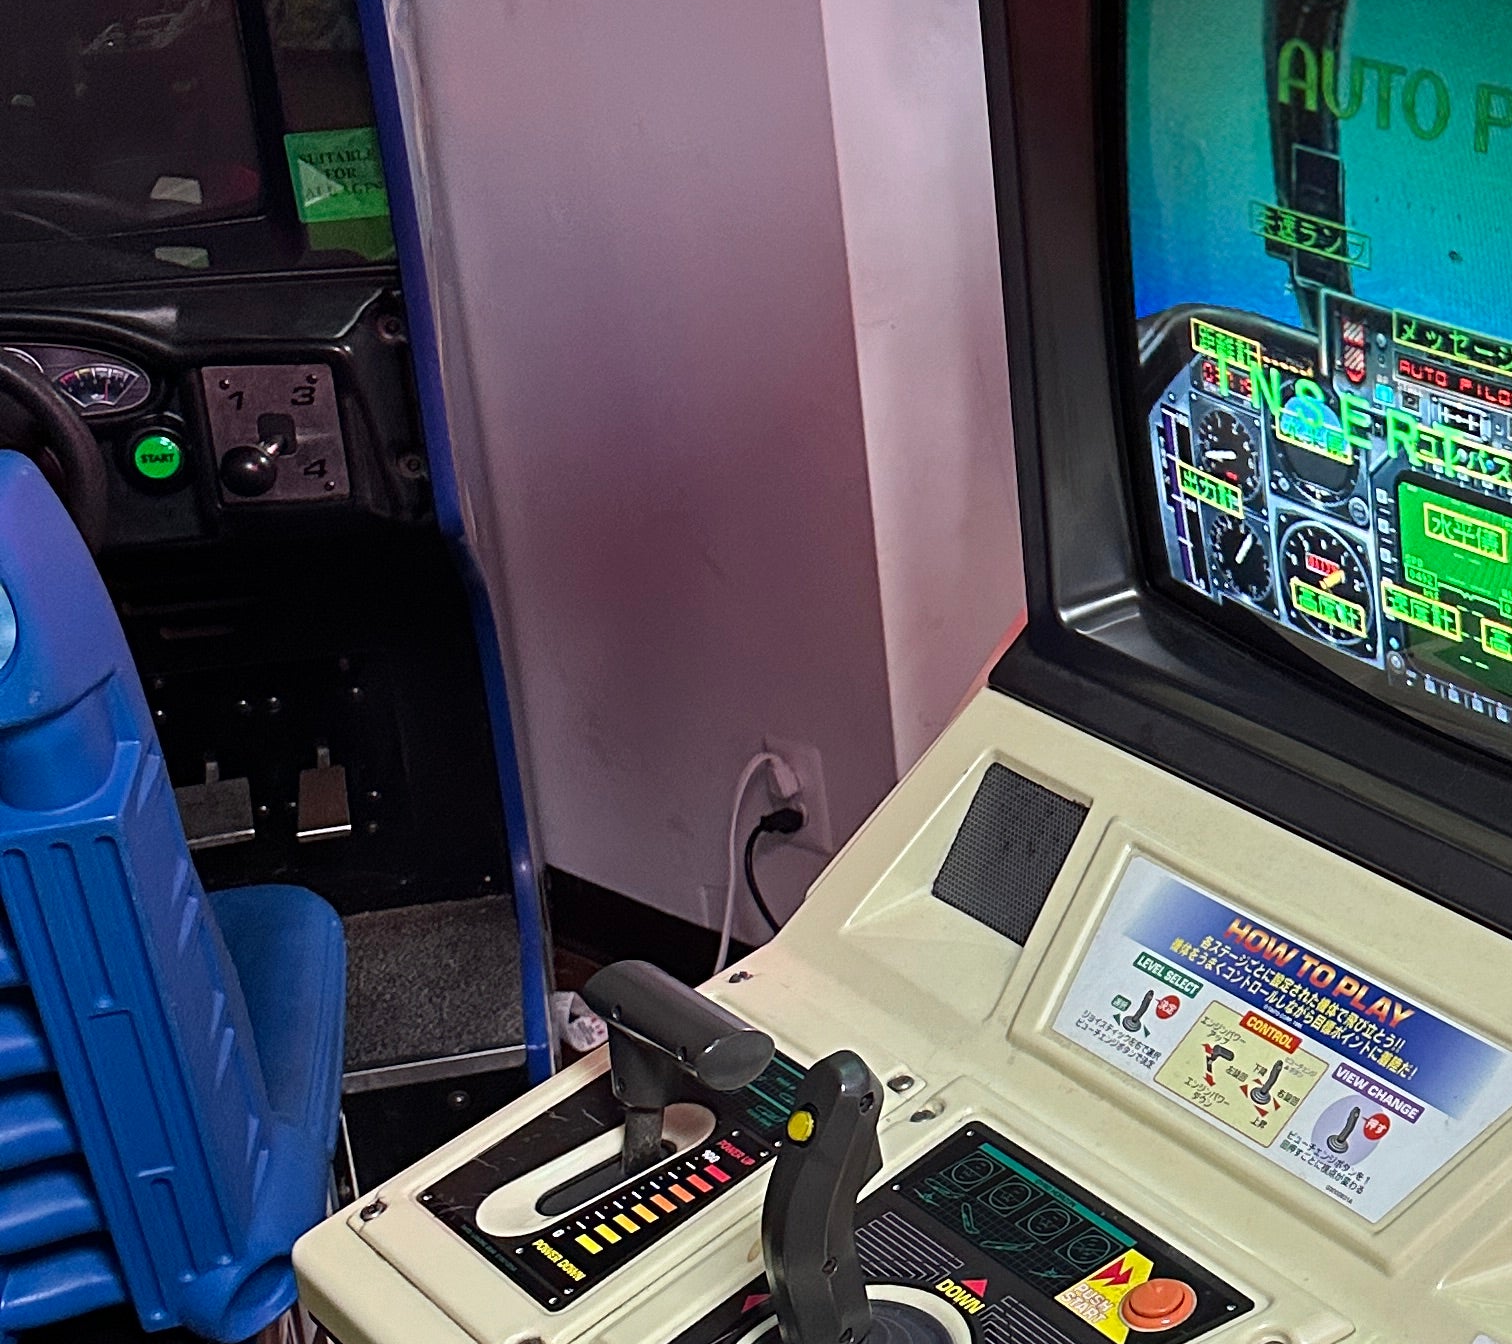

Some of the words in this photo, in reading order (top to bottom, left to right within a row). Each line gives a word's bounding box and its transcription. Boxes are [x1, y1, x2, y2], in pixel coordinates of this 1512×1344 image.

[1276, 38, 1451, 140] AUTO
[1399, 359, 1448, 388] AUTO
[228, 391, 244, 410] 1
[291, 387, 315, 405] 3
[1212, 351, 1465, 478] INSERT
[141, 454, 175, 464] START
[304, 459, 327, 478] 4
[1137, 955, 1164, 976] LEVEL
[1164, 970, 1199, 995] SELECT
[1224, 918, 1299, 968] HOW
[1296, 954, 1336, 988] TO
[1332, 974, 1416, 1029] PLAY
[1246, 1016, 1297, 1049] CONTROL
[1336, 1066, 1369, 1092] VIEW
[1368, 1086, 1419, 1119] CHANGE
[1366, 1119, 1387, 1133] 押す
[532, 1239, 564, 1263] POWER
[558, 1257, 586, 1281] DOWN
[936, 1279, 985, 1314] DOWN
[1062, 1291, 1108, 1325] START
[1073, 1282, 1115, 1313] PUSH
